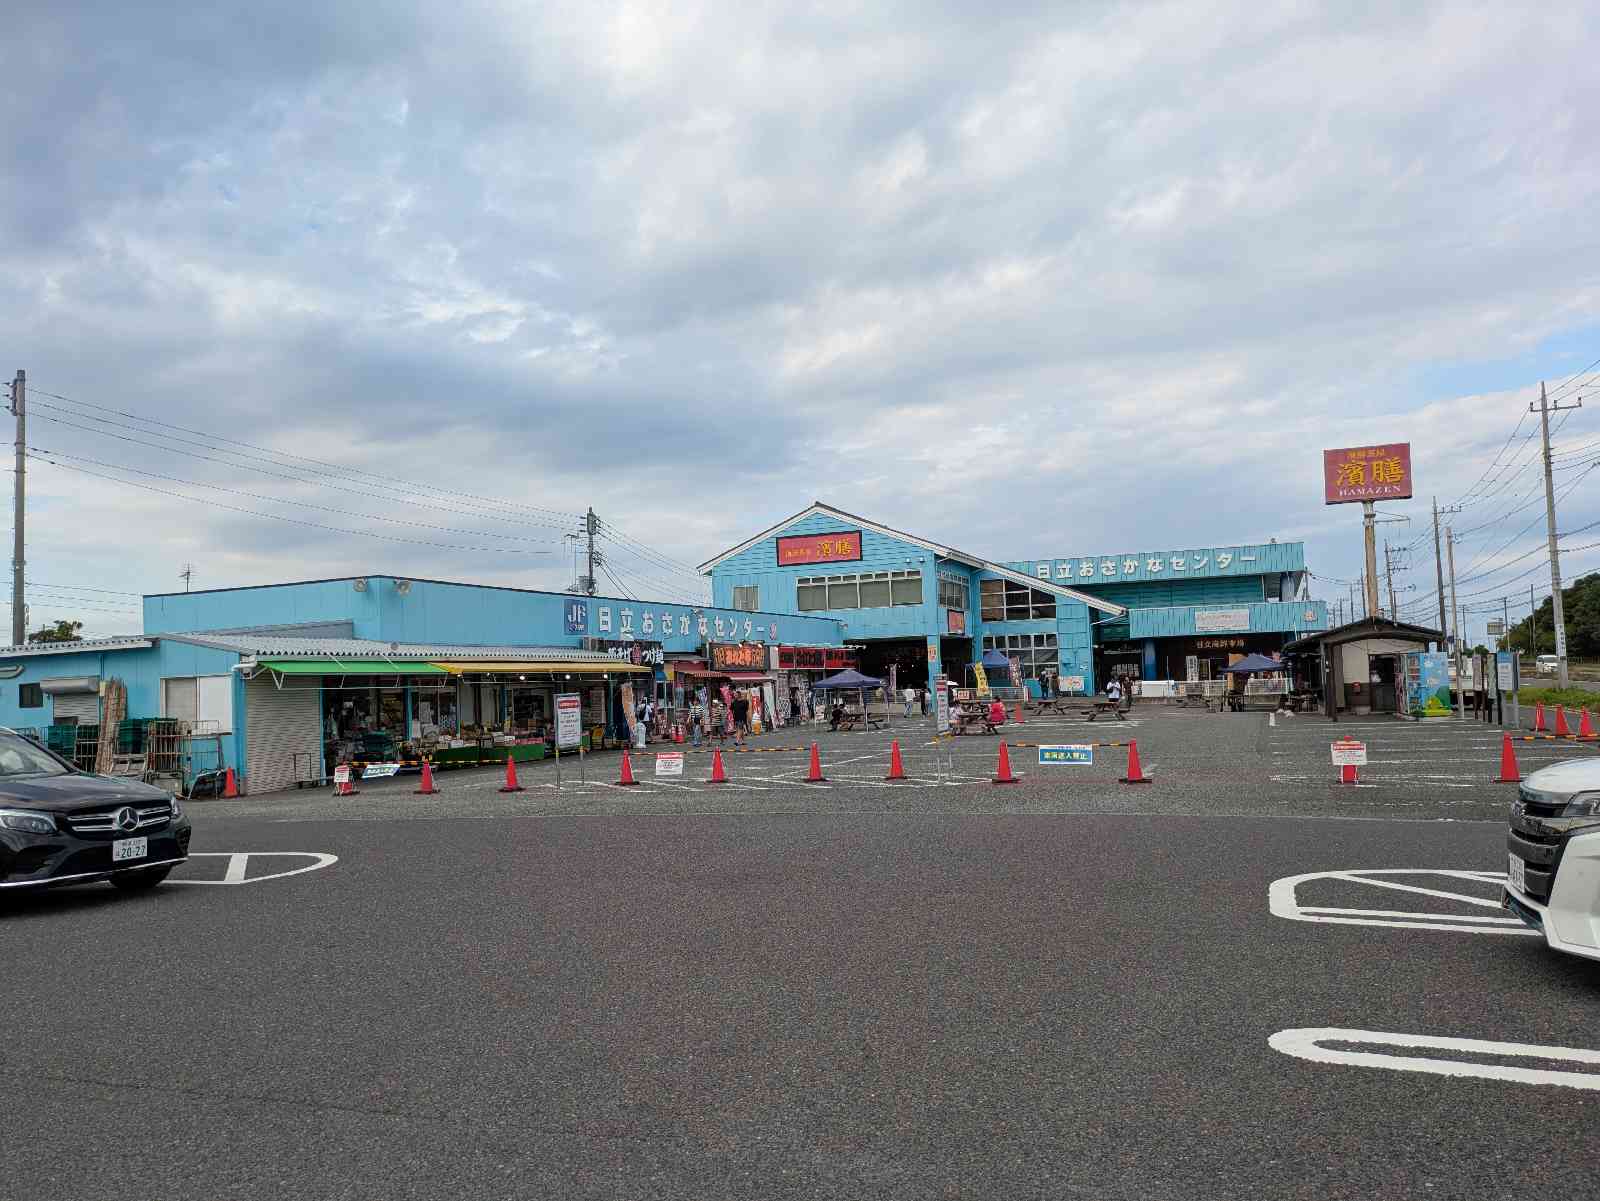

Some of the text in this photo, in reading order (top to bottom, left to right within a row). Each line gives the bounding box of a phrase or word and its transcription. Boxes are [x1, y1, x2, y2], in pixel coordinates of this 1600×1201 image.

[1336, 456, 1405, 487] 濱膳
[1338, 485, 1402, 497] HAMAZEN
[1037, 553, 1256, 579] 日立おさかなセンター
[599, 606, 766, 638] 日立おさかなセンター
